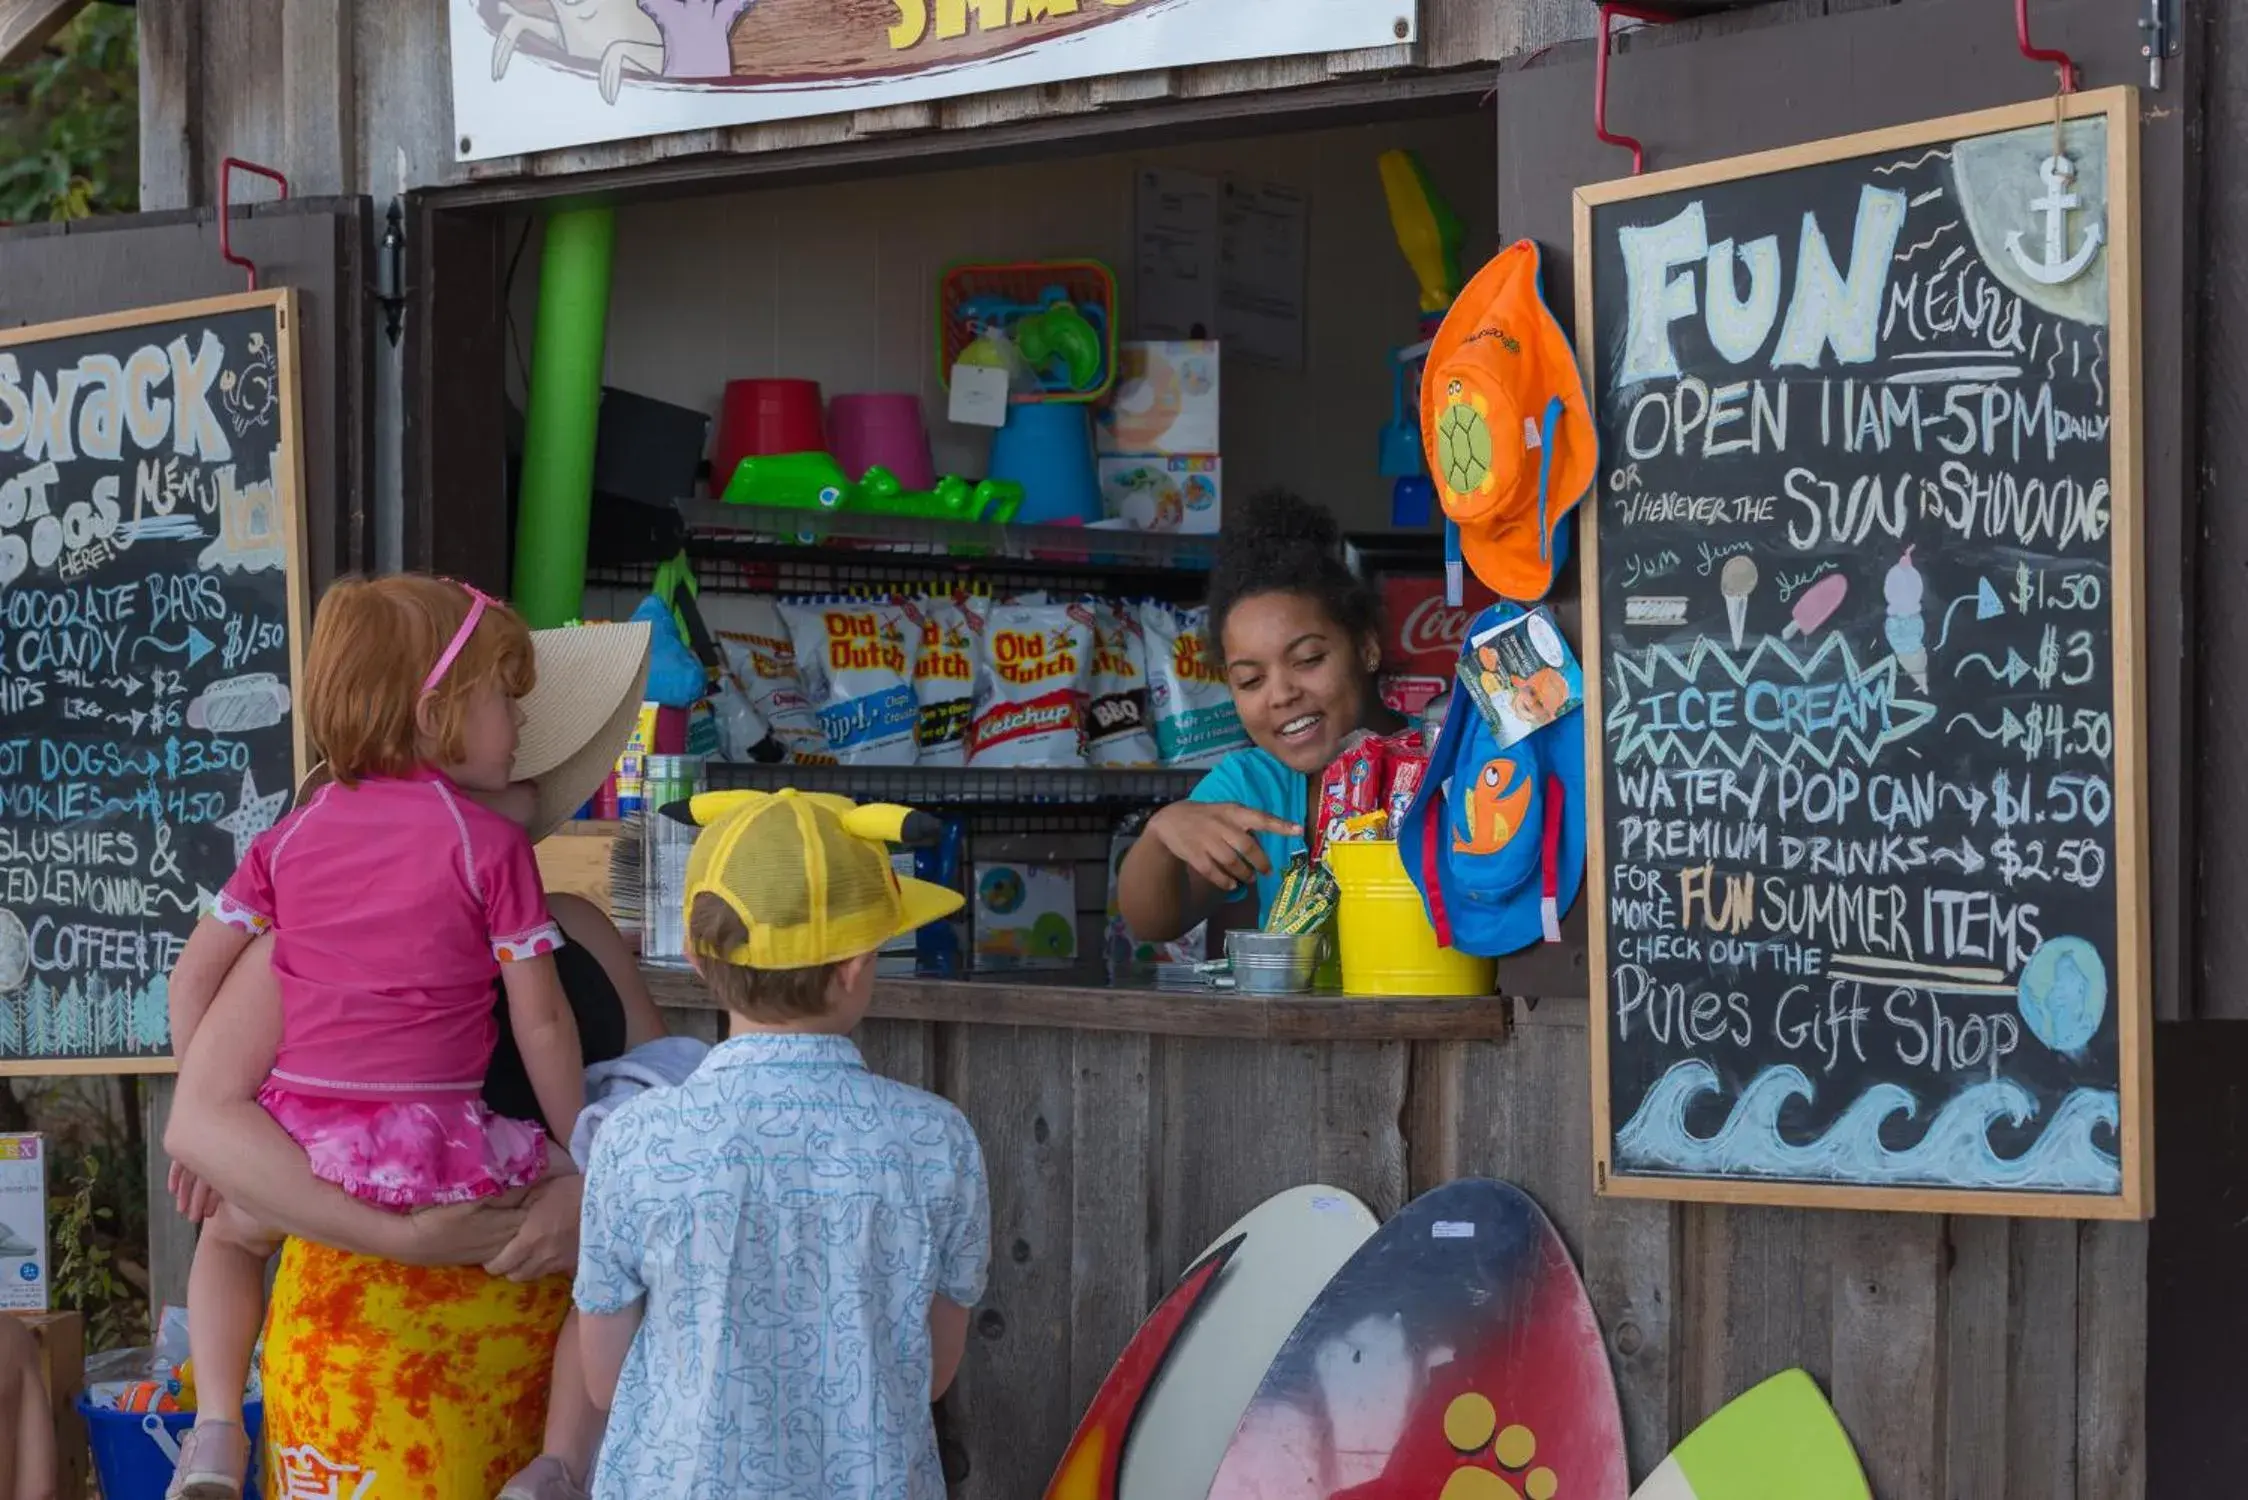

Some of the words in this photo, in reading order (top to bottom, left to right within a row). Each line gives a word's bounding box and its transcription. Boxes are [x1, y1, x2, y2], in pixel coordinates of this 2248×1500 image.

[1617, 183, 1908, 386] FUN
[1625, 376, 1789, 460] OPEN
[2053, 406, 2110, 442] DAILY
[1609, 462, 1643, 493] OR
[1615, 491, 1732, 526] WHENEVER
[1732, 495, 1778, 523] THE
[1784, 467, 1912, 551] SUN
[58, 540, 116, 580] HERE!
[145, 572, 227, 634] BARS
[2010, 560, 2102, 617] $1.50
[16, 624, 128, 677] CANDY
[824, 612, 877, 638] Old
[992, 630, 1044, 662] Old
[54, 669, 95, 688] SML
[151, 664, 188, 698] $2
[829, 641, 906, 676] Dutch
[913, 652, 972, 681] utch
[996, 652, 1077, 686] Dutch
[2033, 623, 2096, 690] $3
[150, 699, 183, 735] $6
[978, 703, 1071, 741] Ketchup
[1093, 698, 1139, 727] BBQ
[1638, 686, 1738, 733] ICE
[1744, 680, 1893, 740] CREAM
[2020, 701, 2114, 763] $4.50
[0, 738, 31, 776] OT
[39, 738, 123, 781] DOGS
[1868, 770, 1936, 831] CAN
[1989, 767, 2112, 827] $1.50
[150, 822, 187, 884] &
[1617, 815, 1768, 865] PREMIUM
[1779, 833, 1931, 876] DRINKS
[1991, 823, 2106, 889] $2.50
[42, 863, 162, 917] LEMONADE
[1614, 863, 1668, 899] FOR
[29, 914, 137, 972] COFFEE
[149, 931, 189, 972] TE
[1611, 896, 1677, 931] MORE
[1678, 860, 1756, 935] FUN
[1760, 876, 1914, 961] SUMMER
[1923, 884, 2044, 974] ITEMS
[1617, 935, 1702, 964] CHECK
[1707, 940, 1760, 972] OUT
[1767, 942, 1823, 977] THE
[1613, 962, 1753, 1049] Pines
[1775, 980, 1871, 1073] Gift
[1883, 982, 2021, 1081] Shop
